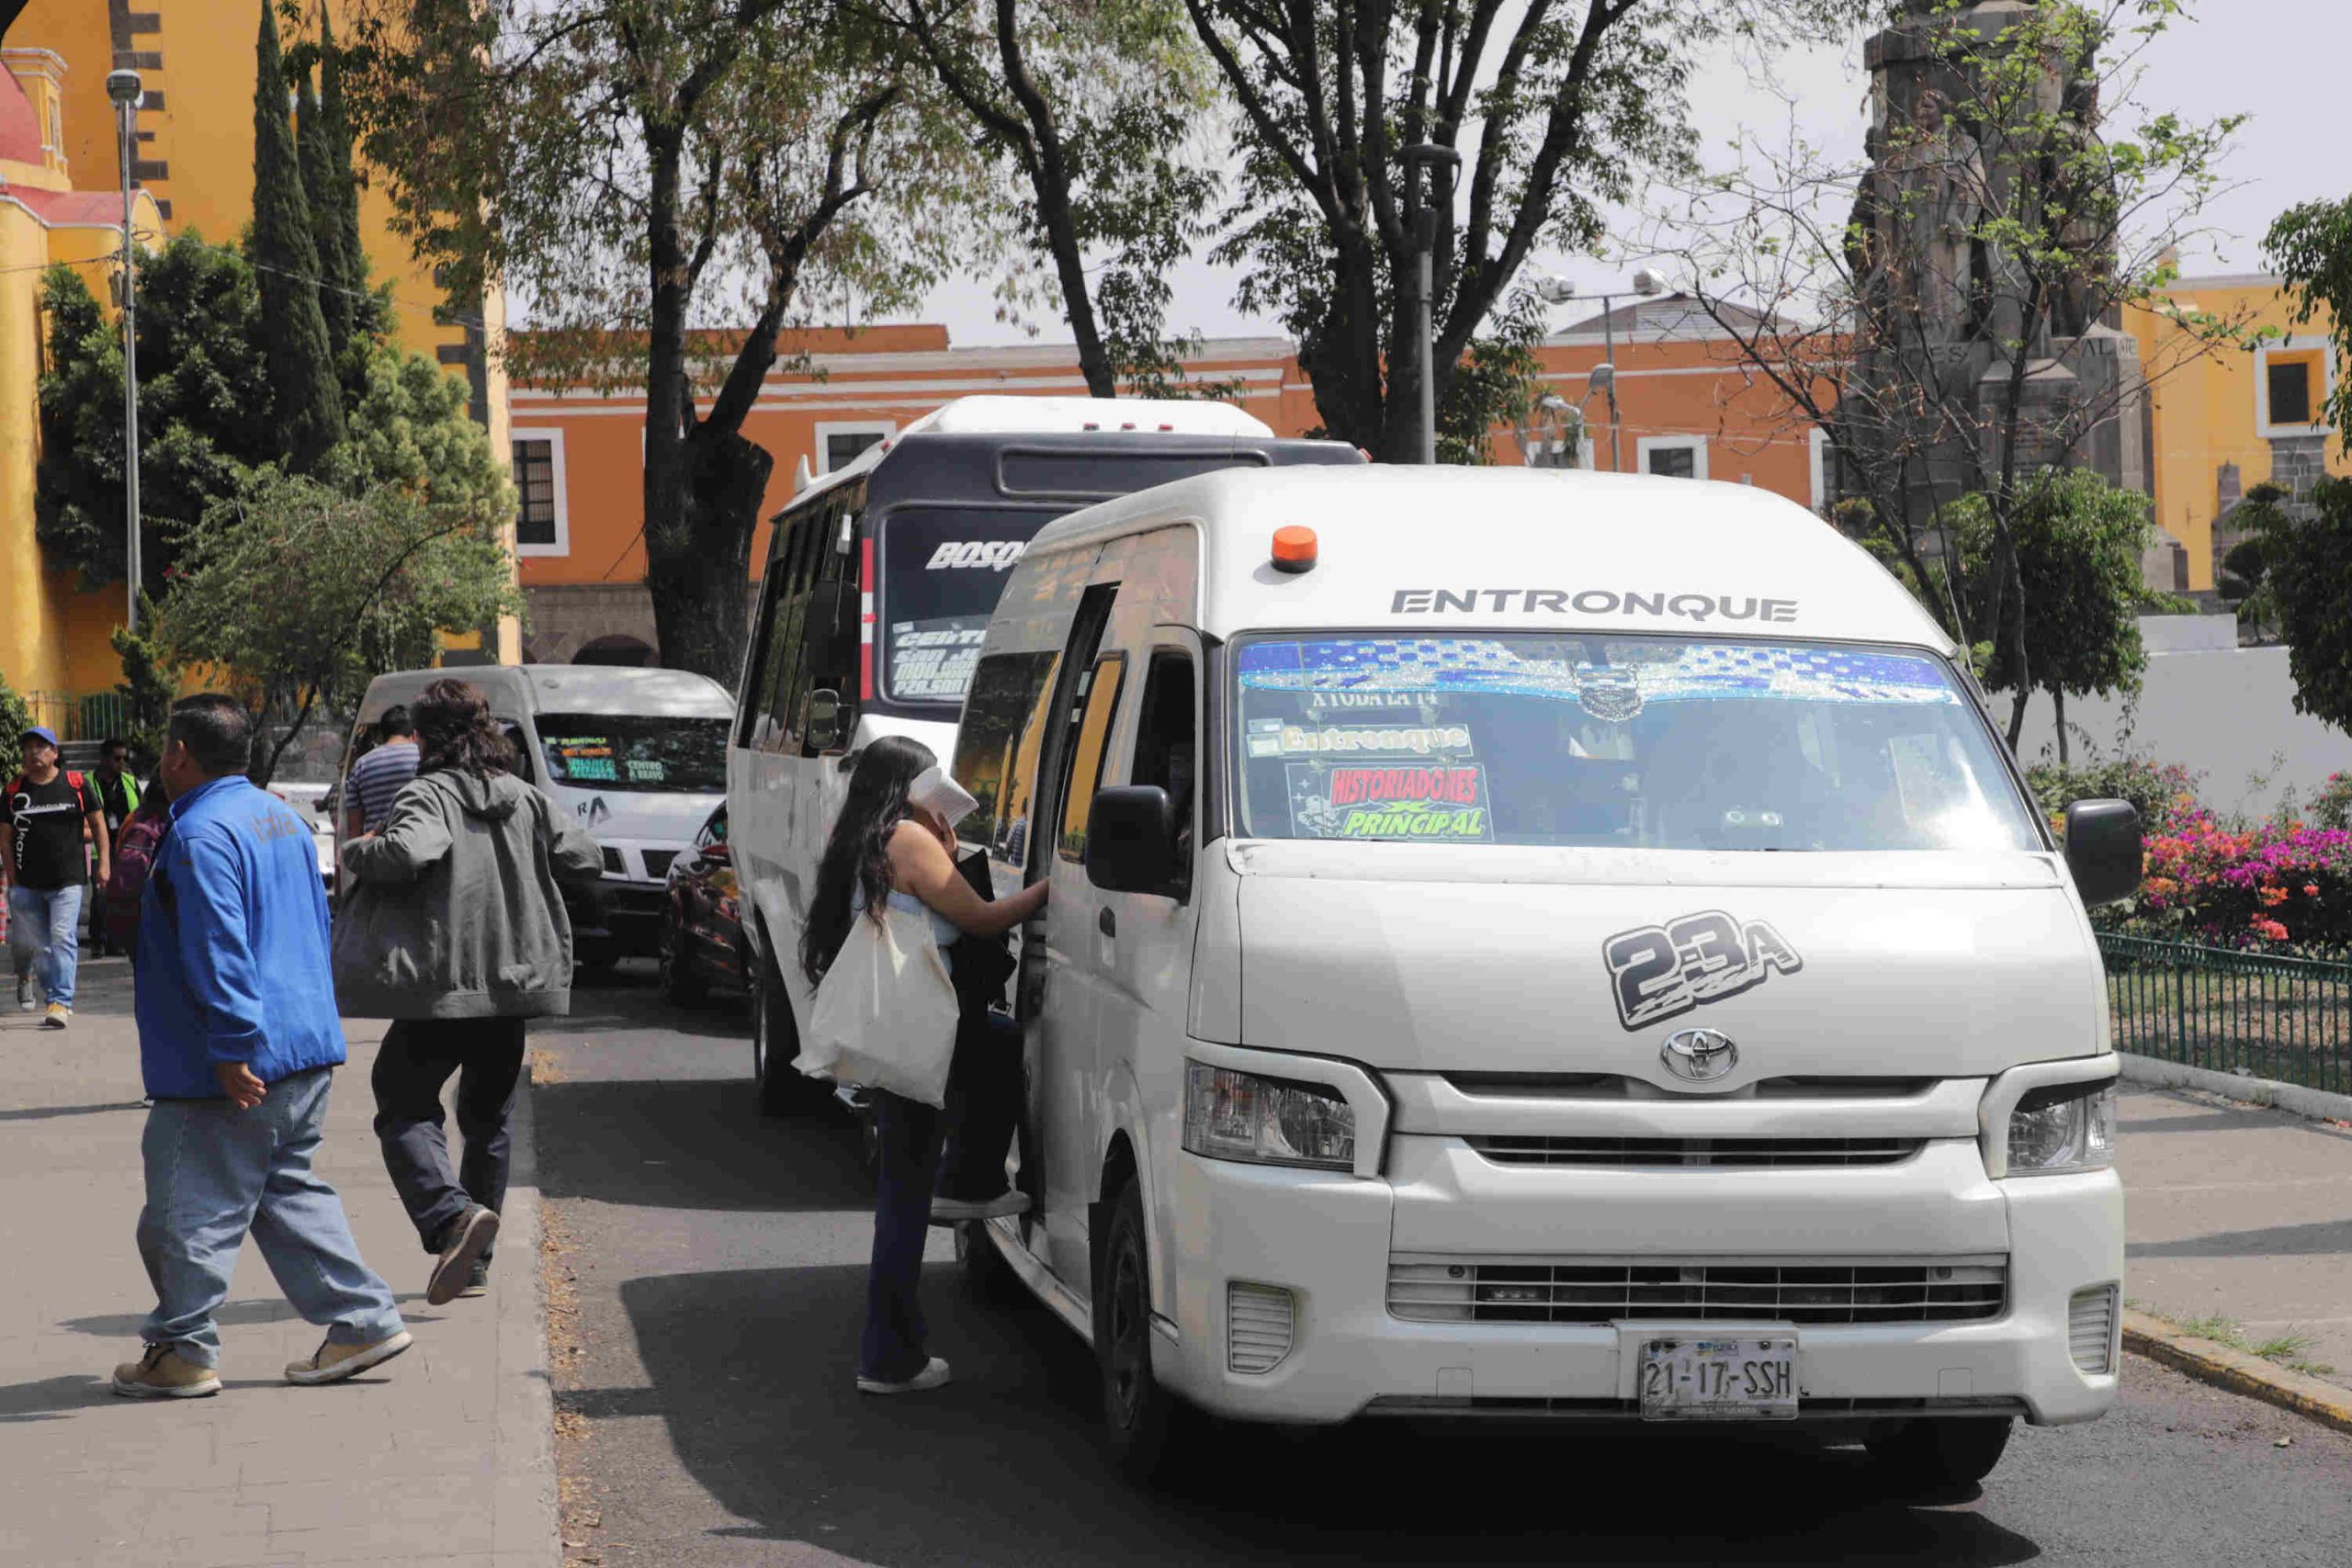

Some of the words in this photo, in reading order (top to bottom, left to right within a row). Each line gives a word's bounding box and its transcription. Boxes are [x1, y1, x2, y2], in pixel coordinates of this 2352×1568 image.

[1390, 589, 1799, 623] ENTRONQUE
[1386, 691, 1412, 707] LA
[1282, 722, 1471, 754] Entronque
[1331, 767, 1477, 807] HISTORIADORES
[1342, 809, 1488, 837] PRINCIPAL
[1602, 909, 1804, 1032] 23A
[1645, 1360, 1791, 1395] 21-17-SSH
